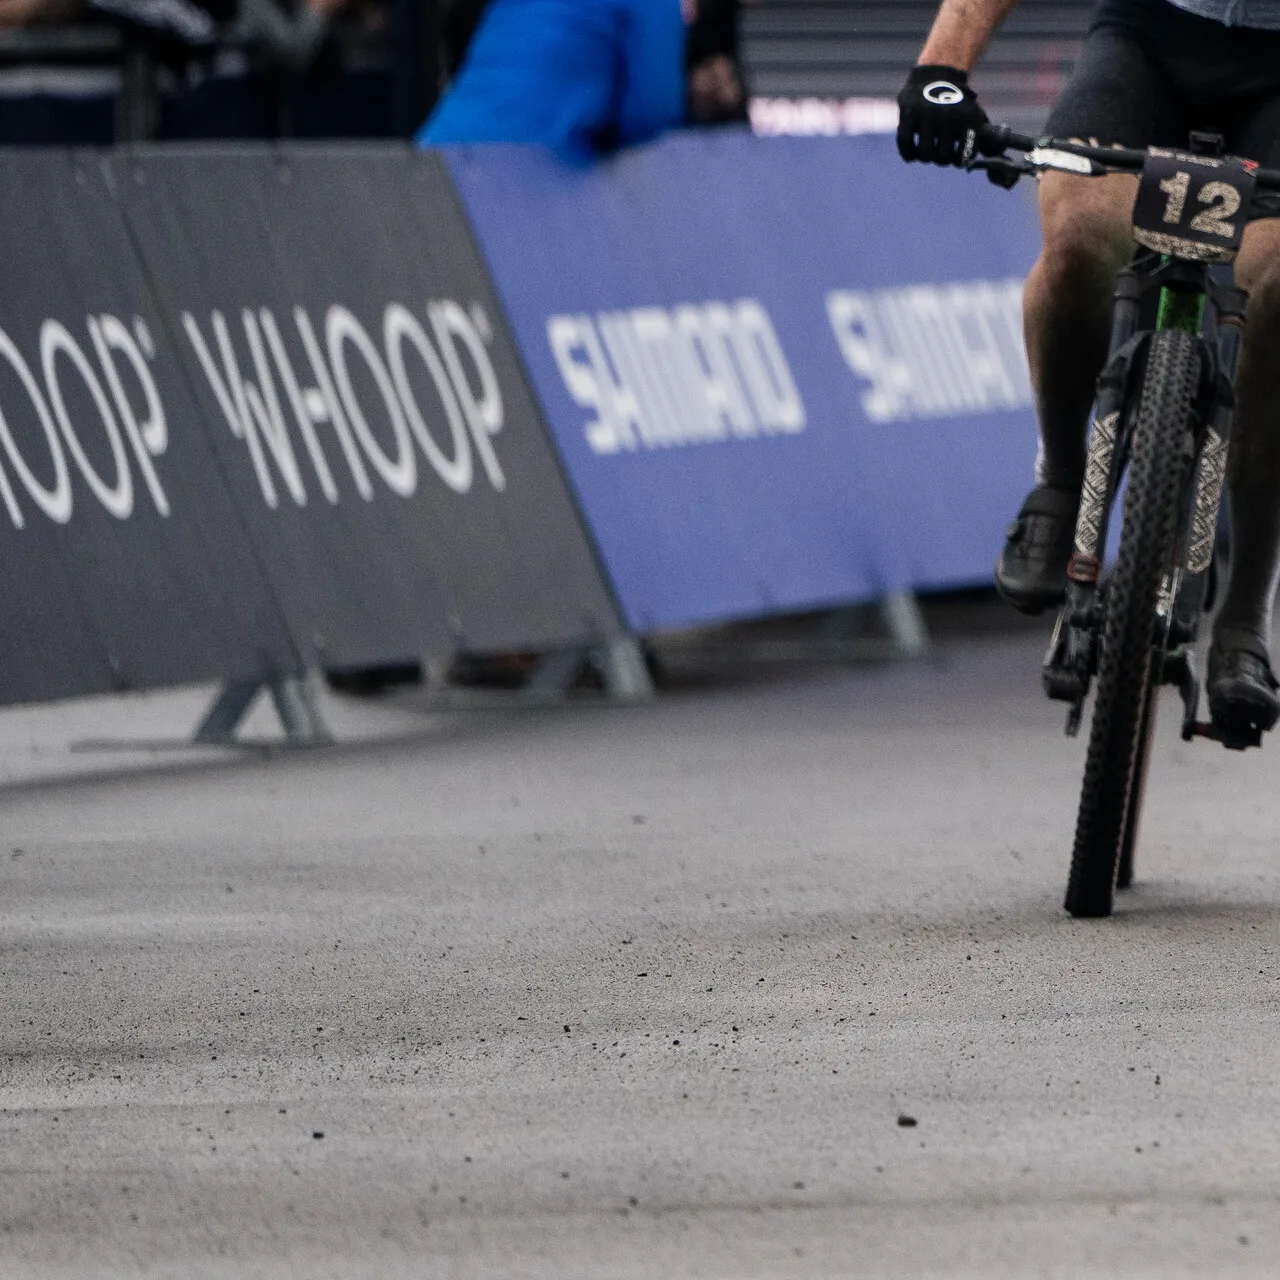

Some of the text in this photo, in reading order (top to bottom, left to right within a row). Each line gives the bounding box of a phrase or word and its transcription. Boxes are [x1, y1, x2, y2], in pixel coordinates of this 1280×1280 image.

[1158, 170, 1242, 239] 12
[181, 298, 506, 509] WHOOP
[546, 297, 808, 455] SHIMANO
